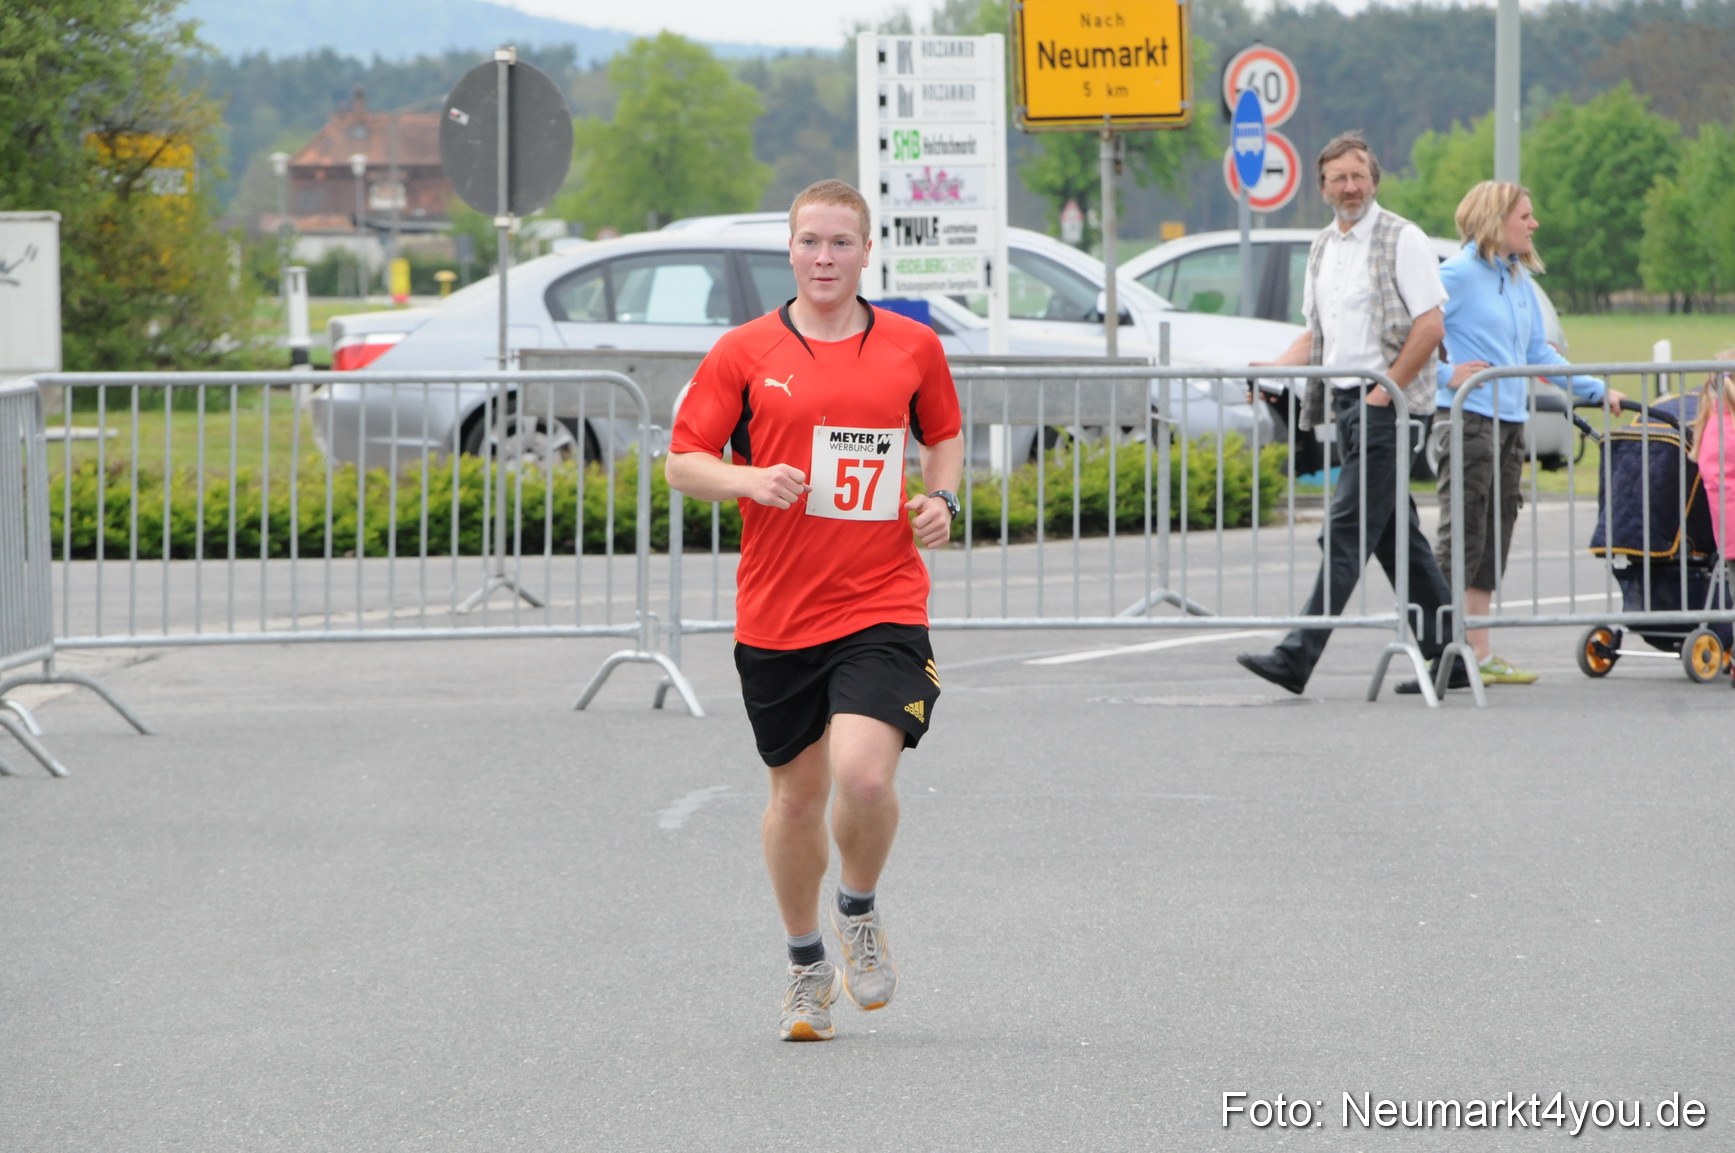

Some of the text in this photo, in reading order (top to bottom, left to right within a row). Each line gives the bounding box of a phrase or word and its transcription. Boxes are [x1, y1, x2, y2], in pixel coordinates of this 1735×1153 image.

[1080, 12, 1125, 28] Nach
[1037, 37, 1169, 70] Neumarkt
[1083, 81, 1129, 98] 5 km
[893, 129, 920, 160] SHB
[894, 217, 939, 246] THULE
[829, 431, 874, 444] MEYER
[829, 442, 874, 453] WERBUNG
[833, 458, 885, 512] 57
